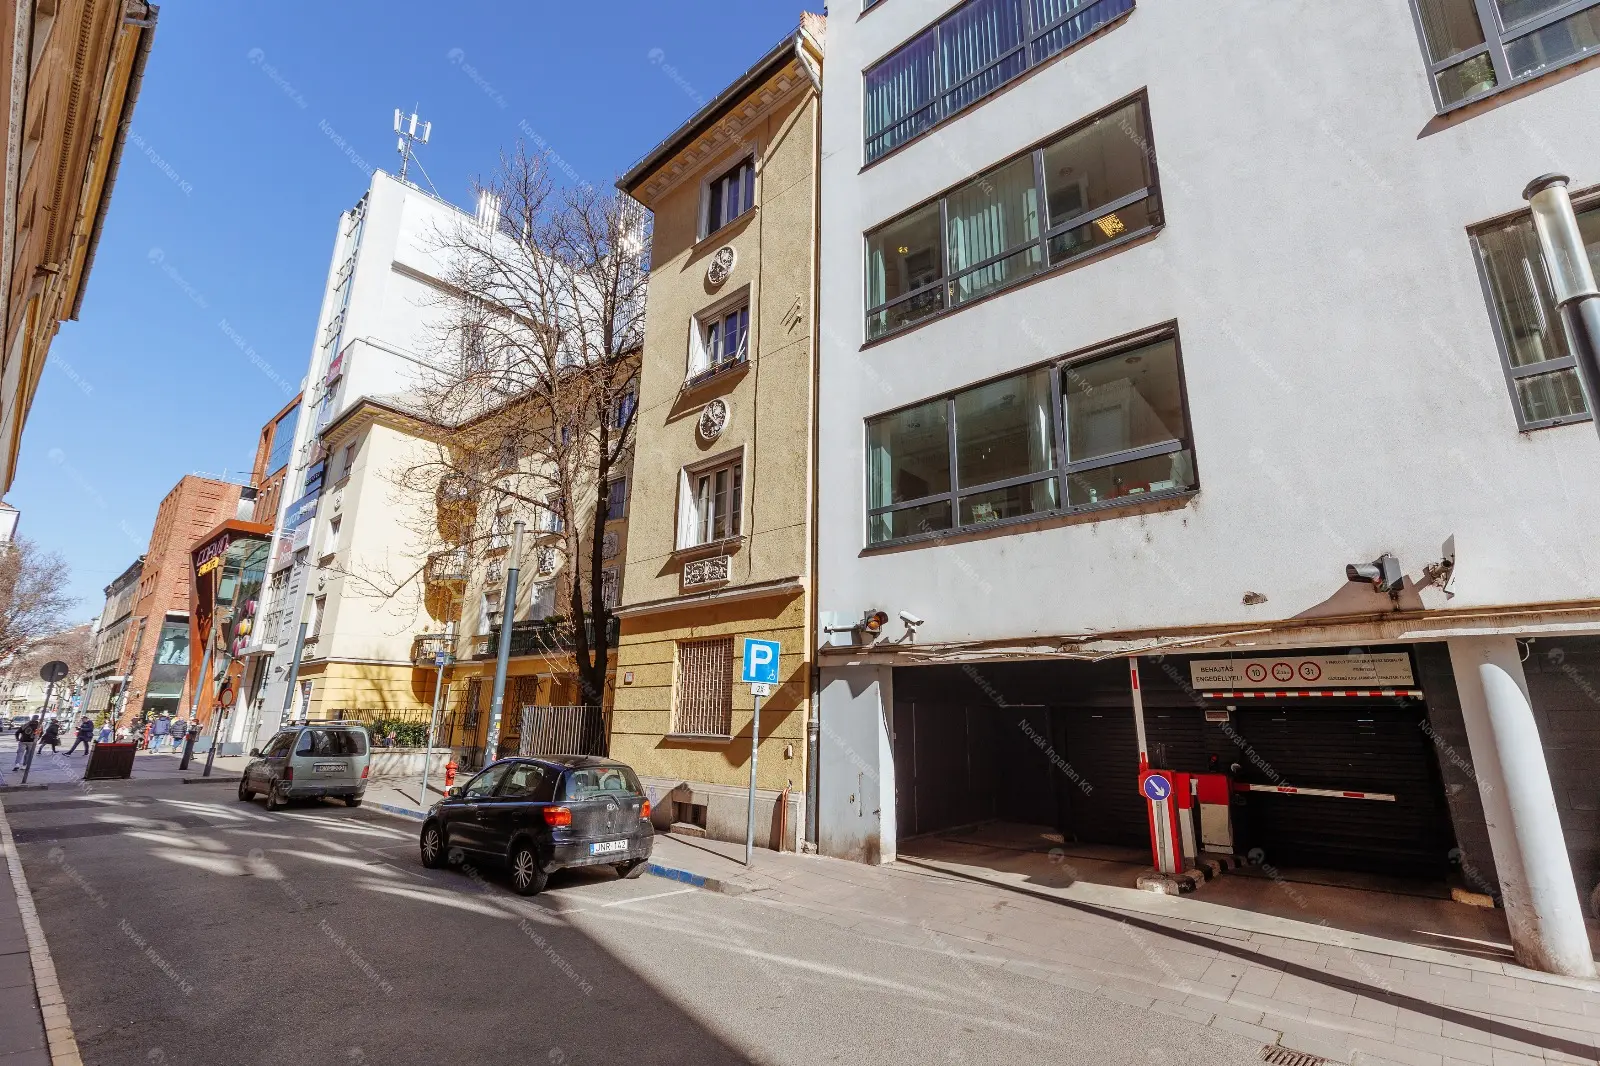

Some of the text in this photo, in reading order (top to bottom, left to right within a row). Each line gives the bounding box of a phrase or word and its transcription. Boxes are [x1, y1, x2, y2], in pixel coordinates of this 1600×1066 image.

[749, 643, 773, 678] P
[1200, 664, 1234, 673] BEHAJTÁS
[1252, 669, 1261, 677] 10
